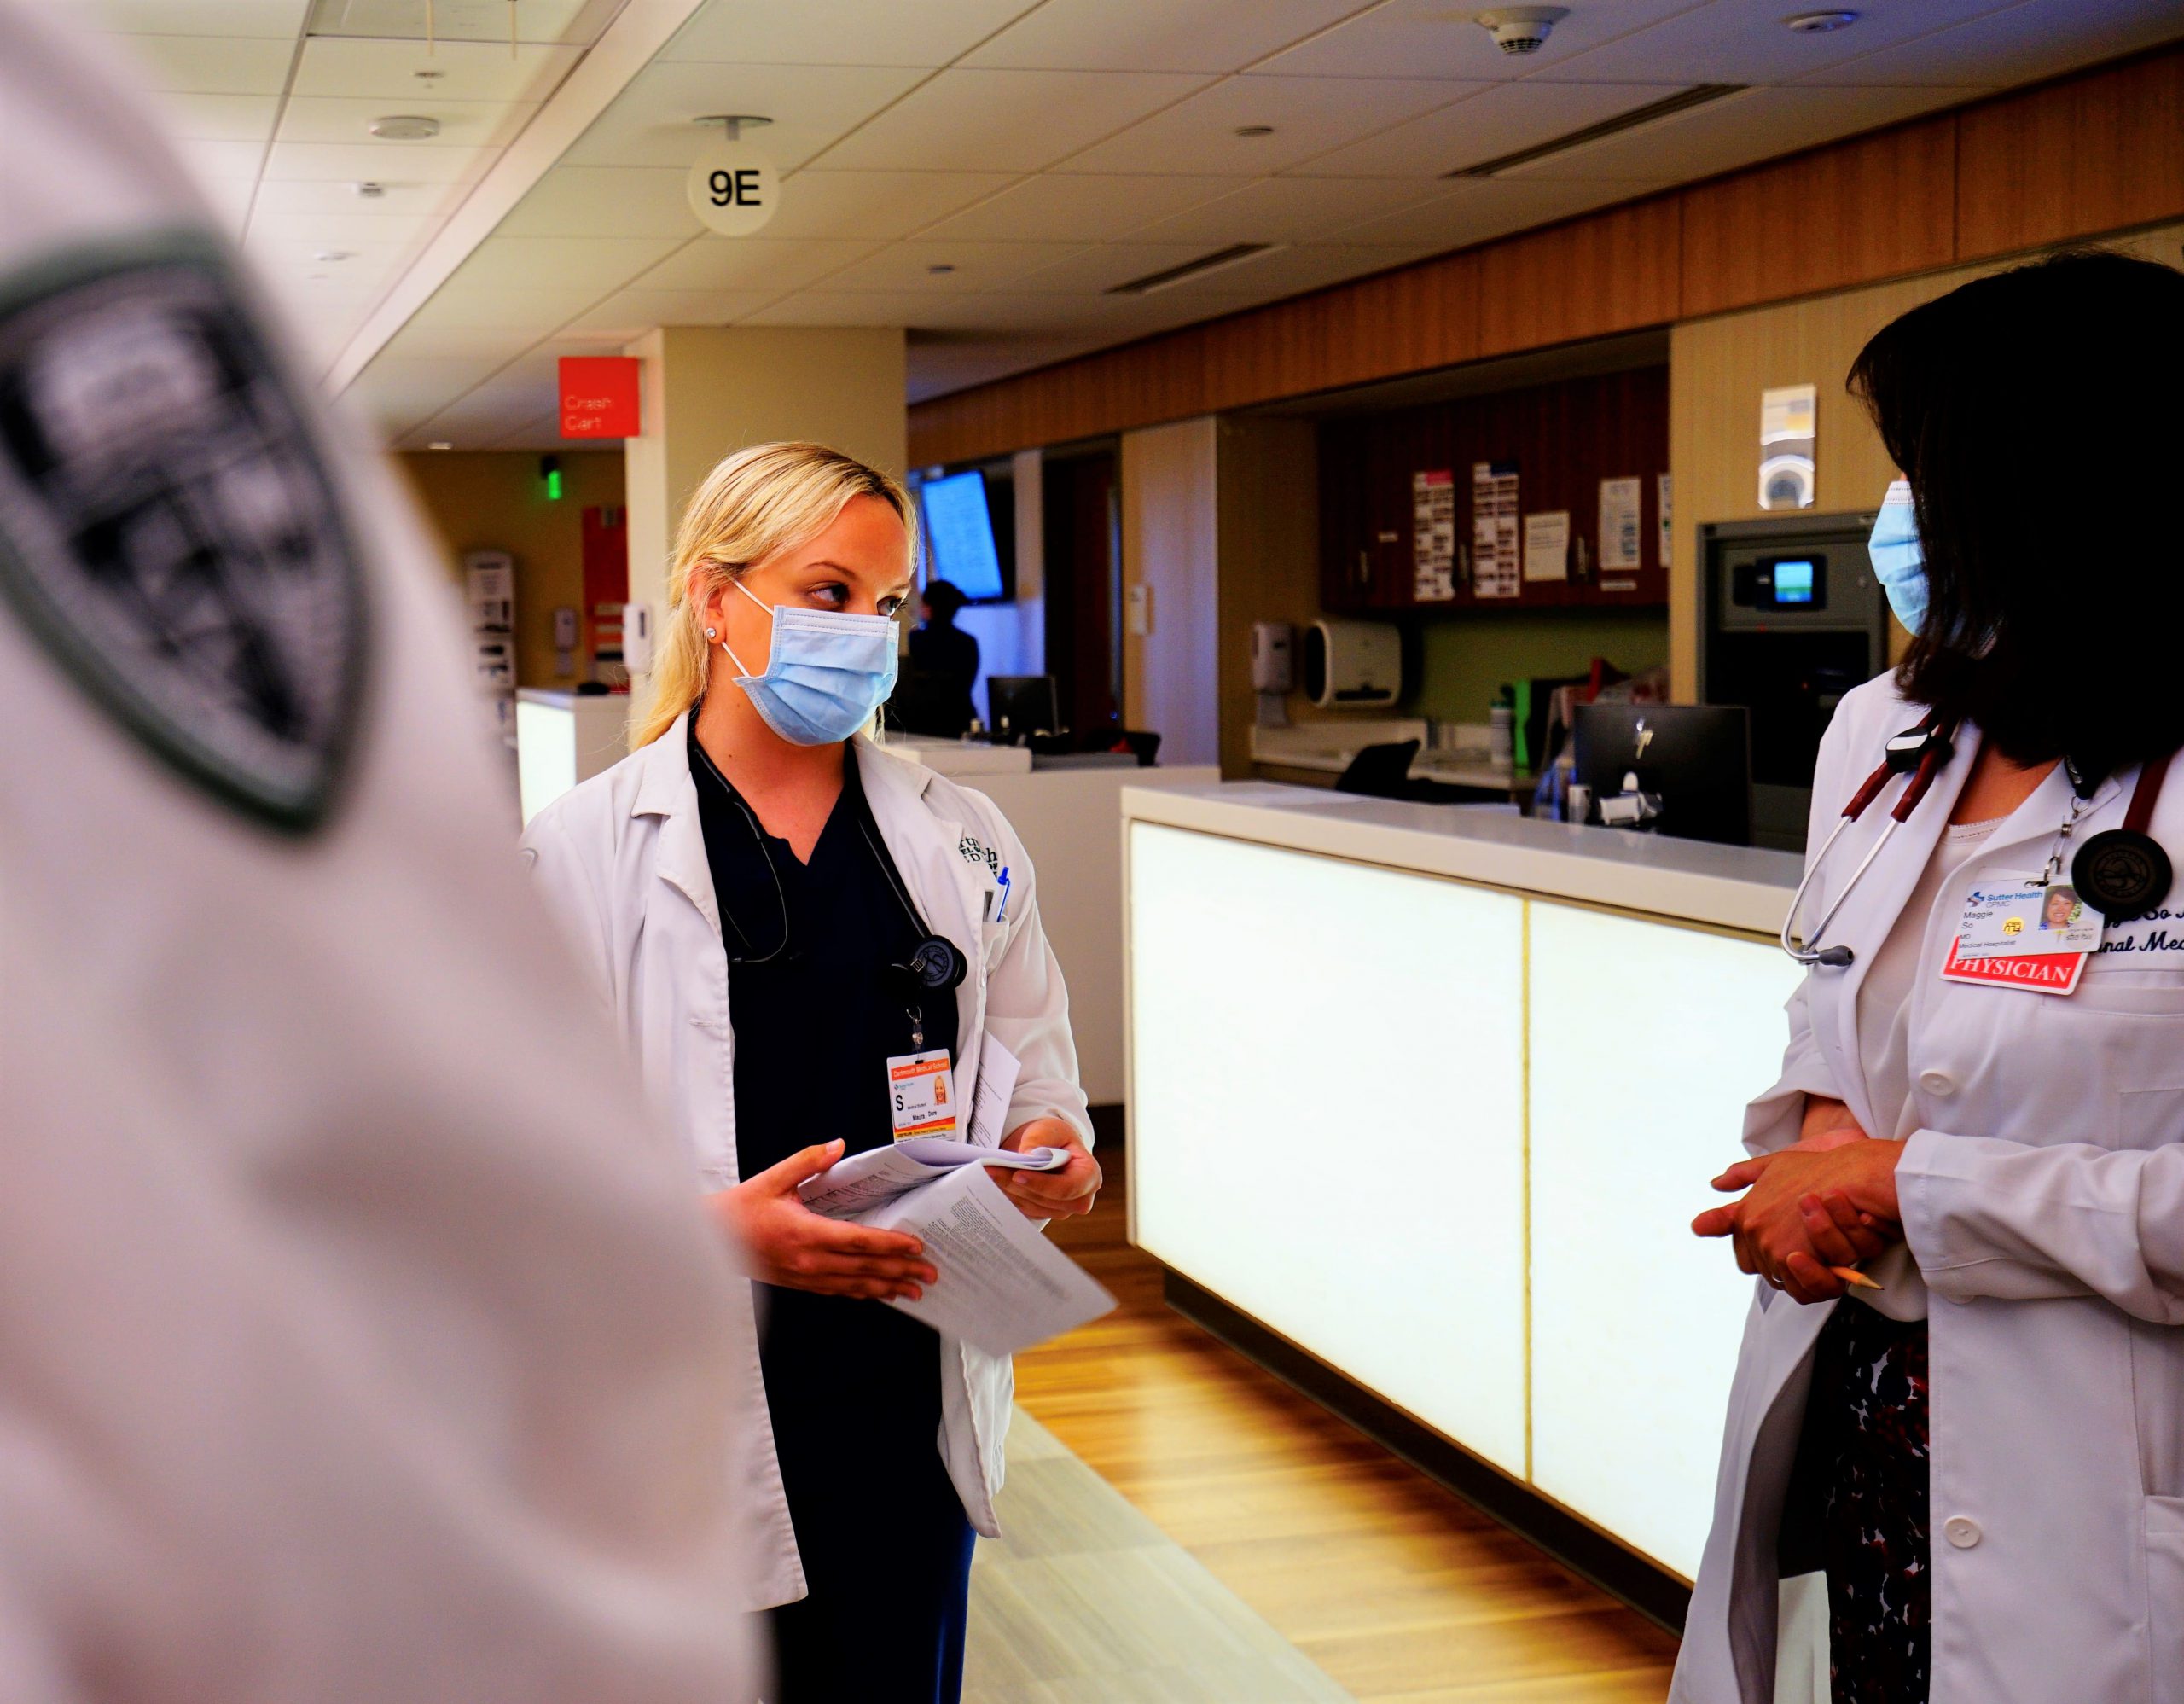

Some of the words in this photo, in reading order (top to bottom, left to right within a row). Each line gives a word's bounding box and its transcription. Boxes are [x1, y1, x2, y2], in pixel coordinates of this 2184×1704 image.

[710, 170, 761, 206] 9E
[565, 395, 613, 410] Crash
[565, 416, 601, 431] Cart
[1986, 893, 2013, 902] Sutter
[2014, 891, 2042, 899] Health
[1963, 910, 1993, 919] Maggie
[1984, 939, 2016, 948] Hospitalist
[1949, 957, 2071, 982] PHYSICIAN
[896, 1095, 903, 1111] S
